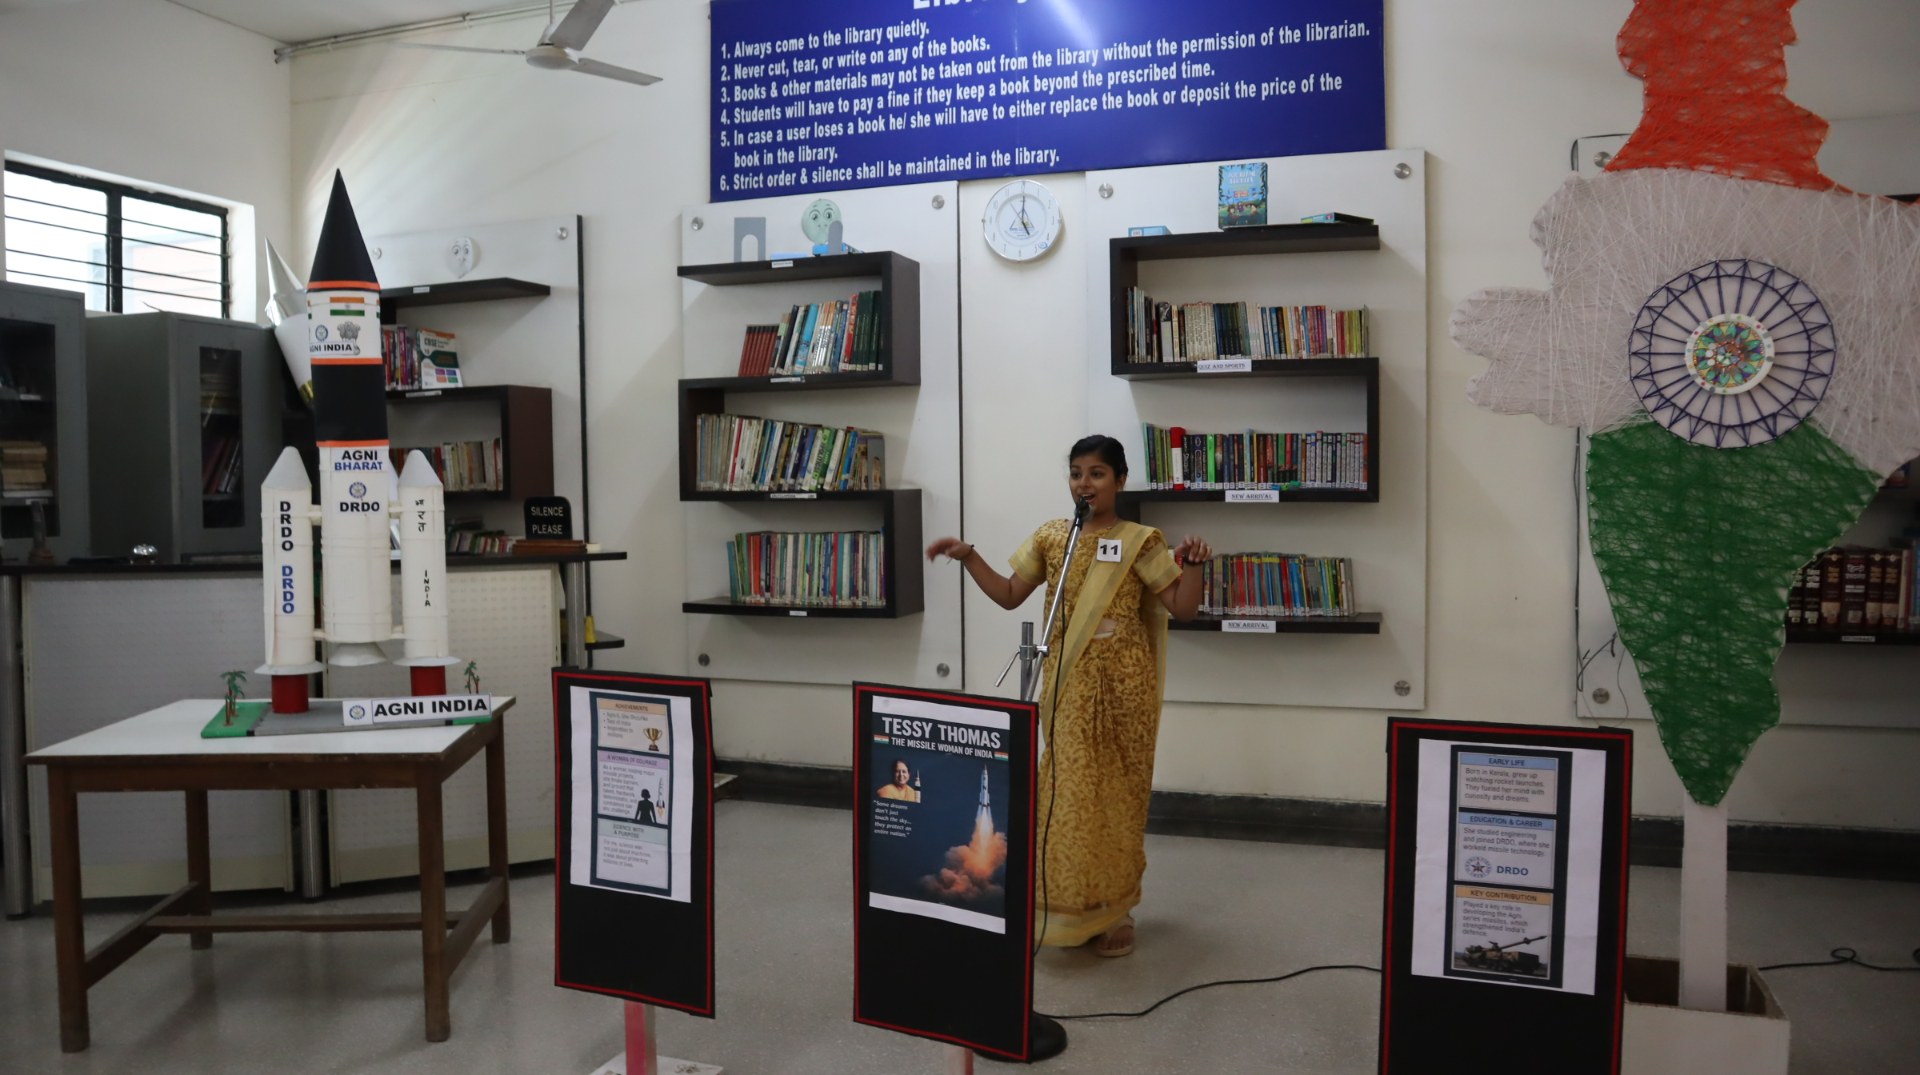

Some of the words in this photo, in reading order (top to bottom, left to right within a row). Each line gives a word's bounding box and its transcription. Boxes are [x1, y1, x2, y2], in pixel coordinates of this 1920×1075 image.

[721, 43, 730, 59] 1.
[734, 41, 772, 59] Always
[775, 38, 804, 53] come
[808, 33, 819, 49] to
[823, 30, 841, 47] the
[845, 27, 883, 45] library
[886, 18, 929, 43] quietly.
[721, 65, 730, 81] 2.
[734, 63, 765, 80] Never
[768, 59, 789, 77] cut,
[793, 57, 818, 74] tear,
[822, 56, 834, 70] or
[837, 50, 866, 68] write
[870, 50, 884, 64] on
[888, 47, 908, 65] any
[912, 41, 924, 59] of
[928, 39, 947, 57] the
[951, 34, 990, 54] books.
[721, 87, 730, 103] 3.
[734, 84, 766, 102] Books
[770, 81, 778, 98] &
[782, 79, 811, 97] other
[814, 72, 867, 93] materials
[871, 72, 895, 89] may
[898, 66, 917, 83] not
[921, 64, 935, 81] be
[939, 60, 972, 79] taken
[976, 56, 996, 74] out
[1000, 54, 1028, 71] from
[1032, 50, 1052, 68] the
[1057, 48, 1099, 67] library
[1103, 40, 1152, 61] without
[1156, 38, 1177, 56] the
[1182, 33, 1255, 58] permission
[1260, 27, 1274, 46] of
[1279, 25, 1301, 44] the
[1306, 20, 1370, 42] librarian.
[720, 109, 730, 125] 4.
[734, 105, 781, 124] Students
[785, 101, 805, 118] will
[809, 100, 834, 116] have
[838, 97, 849, 113] to
[853, 97, 873, 115] pay
[877, 96, 884, 109] a
[887, 90, 910, 107] fine
[914, 87, 922, 105] if
[926, 86, 952, 106] they
[956, 83, 985, 102] keep
[989, 83, 996, 97] a
[1000, 76, 1030, 95] book
[1034, 71, 1078, 95] beyond
[1082, 69, 1103, 87] the
[1108, 61, 1176, 90] prescribed
[1181, 61, 1215, 78] time.
[720, 131, 730, 147] 5.
[734, 130, 744, 146] In
[747, 130, 773, 144] case
[776, 129, 783, 142] a
[787, 126, 811, 141] user
[814, 122, 843, 138] loses
[847, 122, 854, 135] a
[858, 115, 885, 134] book
[889, 112, 907, 130] he/
[910, 111, 931, 128] she
[935, 107, 956, 125] will
[961, 106, 988, 123] have
[992, 103, 1005, 120] to
[1009, 99, 1046, 118] either
[1050, 95, 1098, 118] replace
[1102, 92, 1123, 110] the
[1127, 88, 1158, 108] book
[1163, 90, 1176, 105] or
[1181, 82, 1230, 106] deposit
[1234, 80, 1256, 99] the
[1261, 80, 1296, 101] price
[1301, 73, 1314, 93] of
[1320, 72, 1342, 91] the
[734, 150, 760, 168] book
[763, 149, 773, 165] in
[777, 147, 795, 164] the
[798, 145, 838, 163] library.
[720, 175, 729, 191] 6.
[733, 173, 763, 190] Strict
[767, 170, 796, 187] order
[800, 168, 808, 184] &
[812, 166, 852, 183] silence
[856, 161, 884, 180] shall
[888, 160, 902, 176] be
[906, 152, 971, 175] maintained
[976, 151, 987, 168] in
[991, 149, 1011, 167] the
[1015, 147, 1059, 167] library.
[324, 344, 352, 352] INDIA
[342, 450, 378, 460] AGNI
[334, 462, 382, 470] BHARAT
[340, 502, 380, 512] DRDO
[530, 506, 564, 516] SILENCE
[280, 501, 294, 551] DRDO
[532, 524, 562, 534] PLEASE
[1100, 544, 1118, 555] 11
[282, 566, 294, 614] DRDO
[374, 702, 424, 717] AGNI
[432, 699, 487, 713] INDIA
[882, 716, 933, 738] TESSY
[937, 724, 1000, 749] THOMAS
[891, 738, 905, 747] THE
[907, 739, 936, 750] MISSILE
[938, 743, 963, 754] WOMAN
[965, 748, 973, 756] OF
[974, 749, 993, 759] INDIA
[1470, 816, 1507, 824] EDUCATION
[1516, 819, 1542, 827] CAREER
[1497, 866, 1529, 876] DRDO
[1485, 891, 1537, 901] CONTRIBUTION
